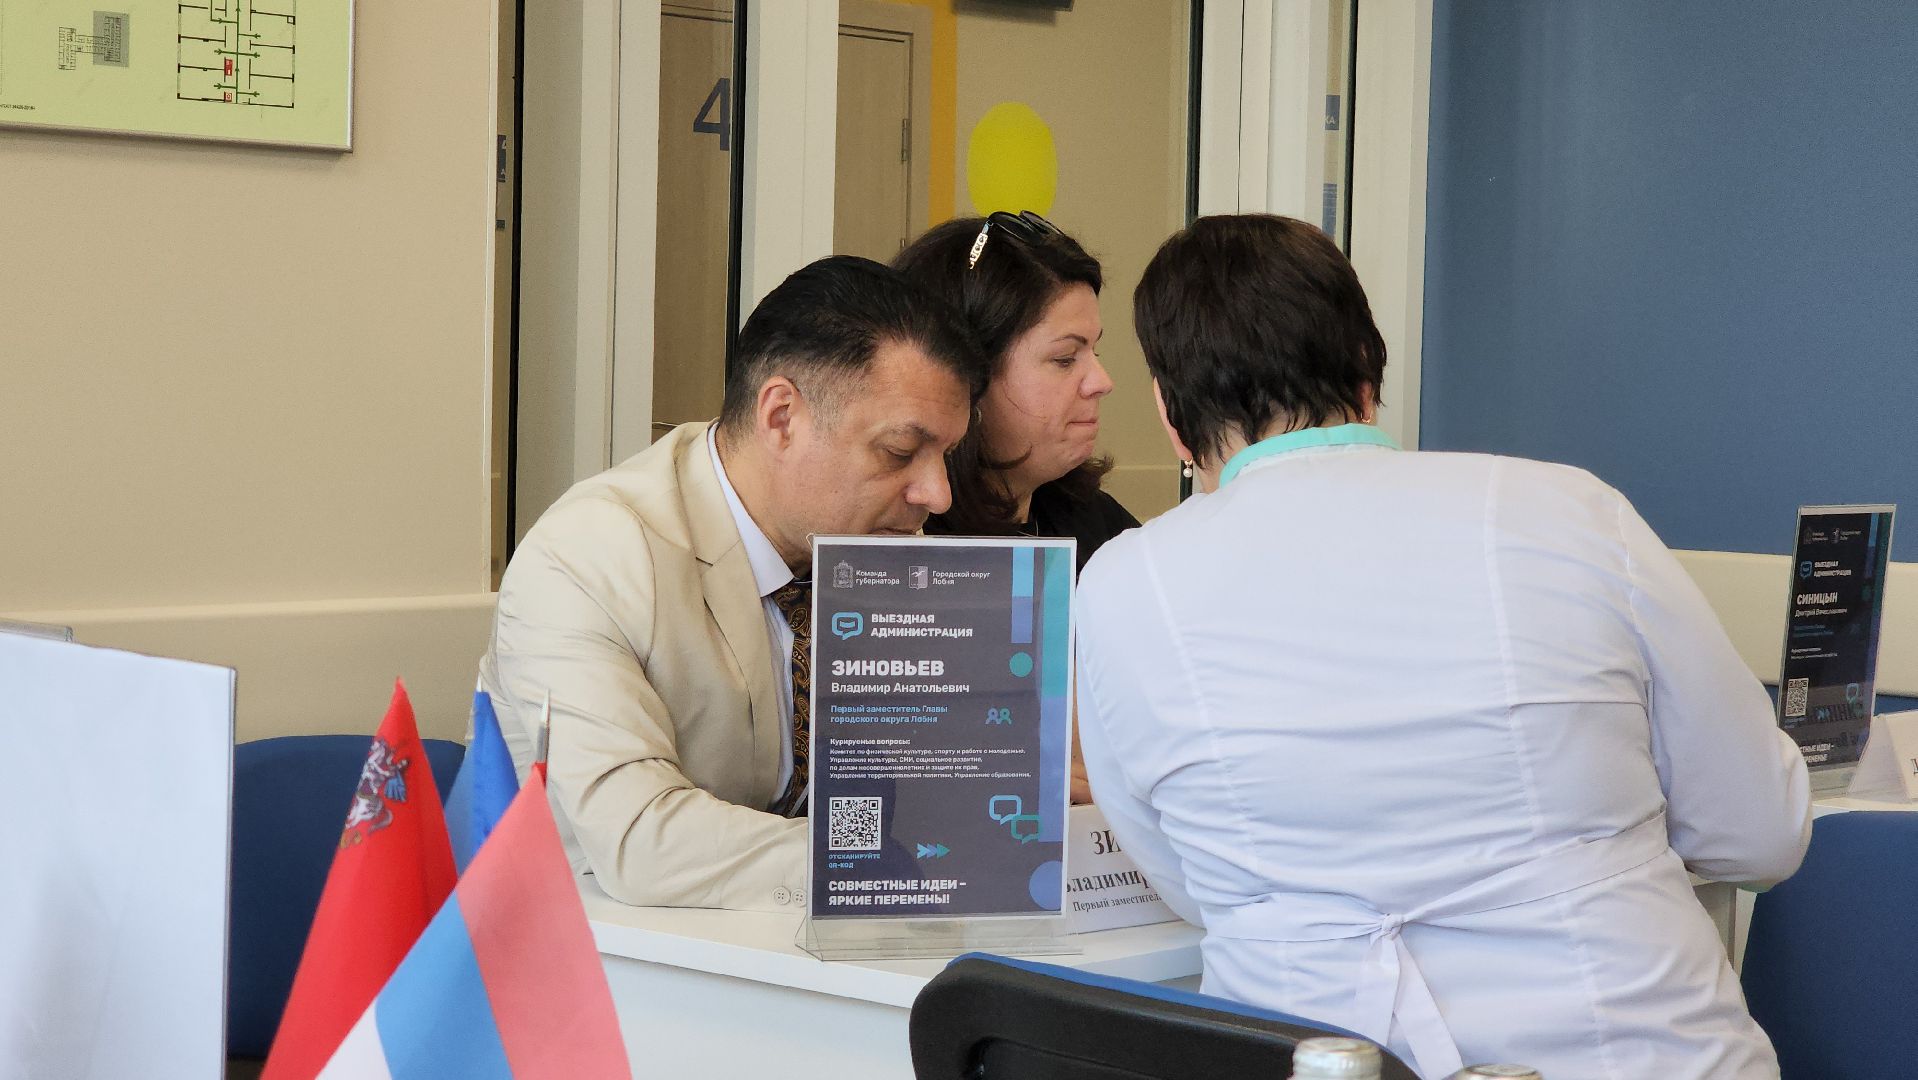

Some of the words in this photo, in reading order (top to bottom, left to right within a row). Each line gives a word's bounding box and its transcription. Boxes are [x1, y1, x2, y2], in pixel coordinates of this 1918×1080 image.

[856, 570, 886, 578] Команда
[932, 570, 969, 578] Городской
[856, 578, 900, 586] губернатора
[1797, 592, 1838, 605] СИНИЦЫН
[871, 614, 934, 624] ВЫЕЗДНАЯ
[870, 628, 973, 638] АДМИНИСТРАЦИЯ
[832, 660, 944, 676] ЗИНОВЬЕВ
[832, 683, 891, 694] Владимир
[893, 683, 970, 692] Анатольевич
[830, 705, 864, 714] Первый
[828, 880, 918, 890] СОВМЕСТНЫЕ
[920, 880, 958, 890] ИДЕИ
[828, 896, 872, 906] ЯРКИЕ
[874, 894, 950, 906] ПЕРЕМЕНЫ!
[1072, 898, 1110, 912] Первый
